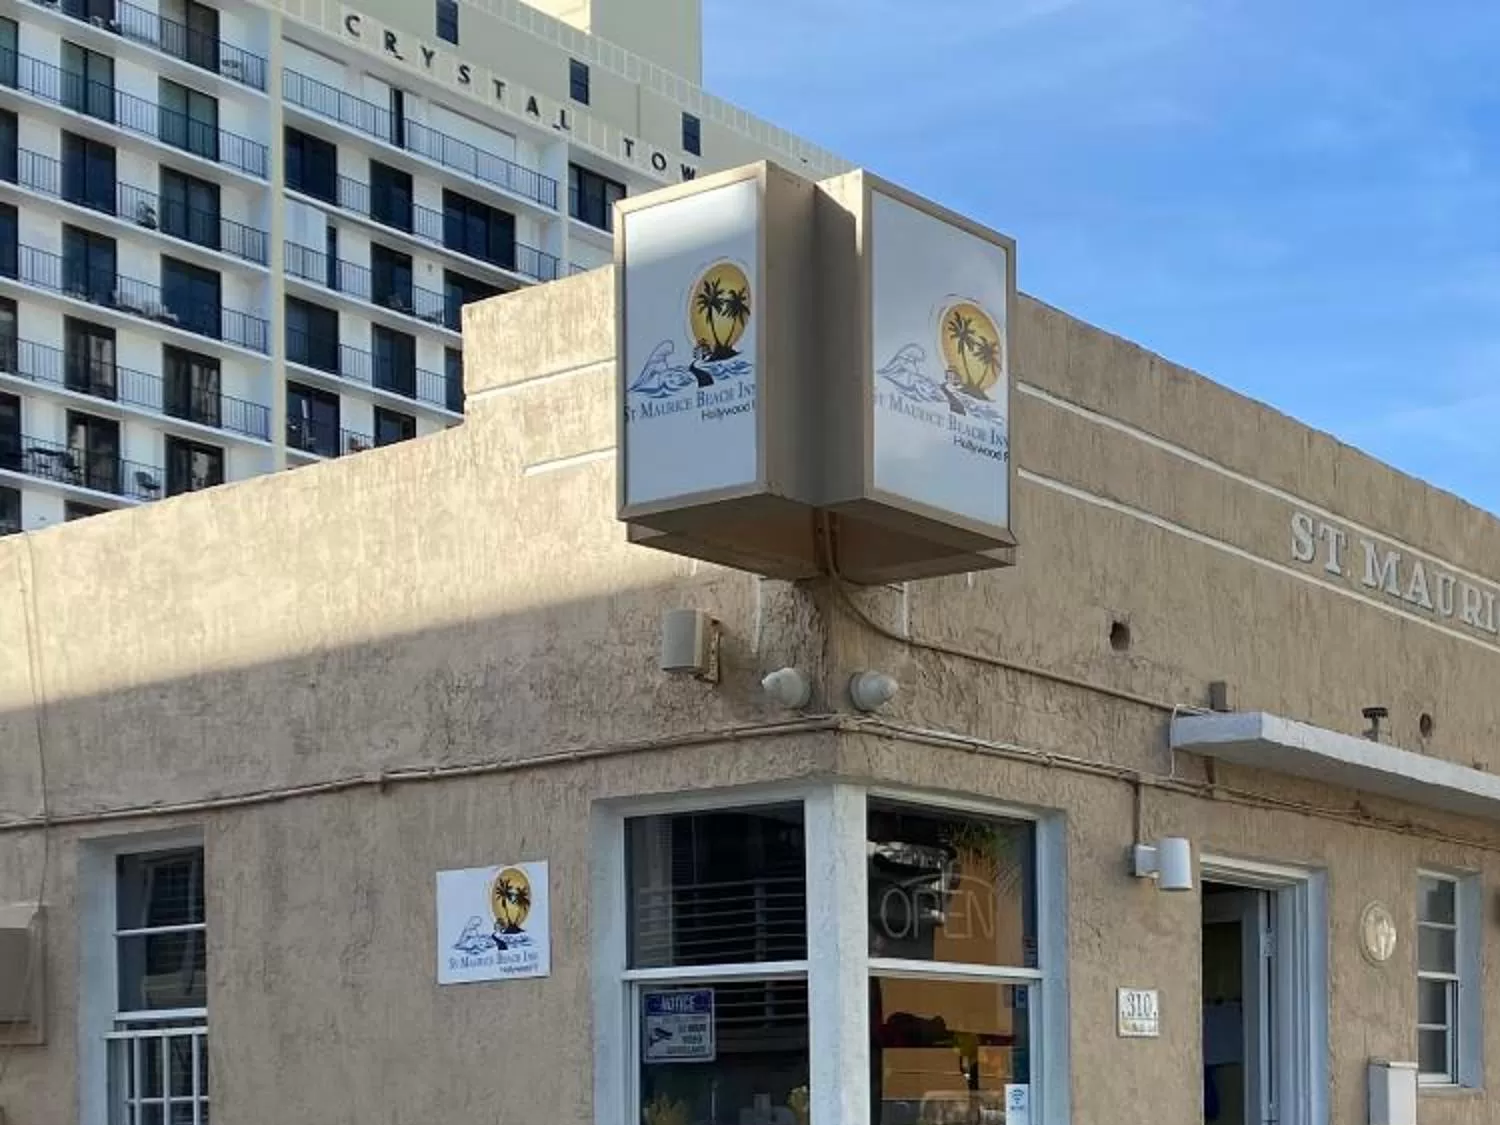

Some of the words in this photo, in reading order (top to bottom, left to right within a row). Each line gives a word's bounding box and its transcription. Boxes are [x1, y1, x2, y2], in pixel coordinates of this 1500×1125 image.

[345, 15, 570, 131] CRYSTAL
[881, 888, 994, 939] OPEN
[661, 993, 697, 1014] NOTICE
[1127, 992, 1152, 1016] 310
